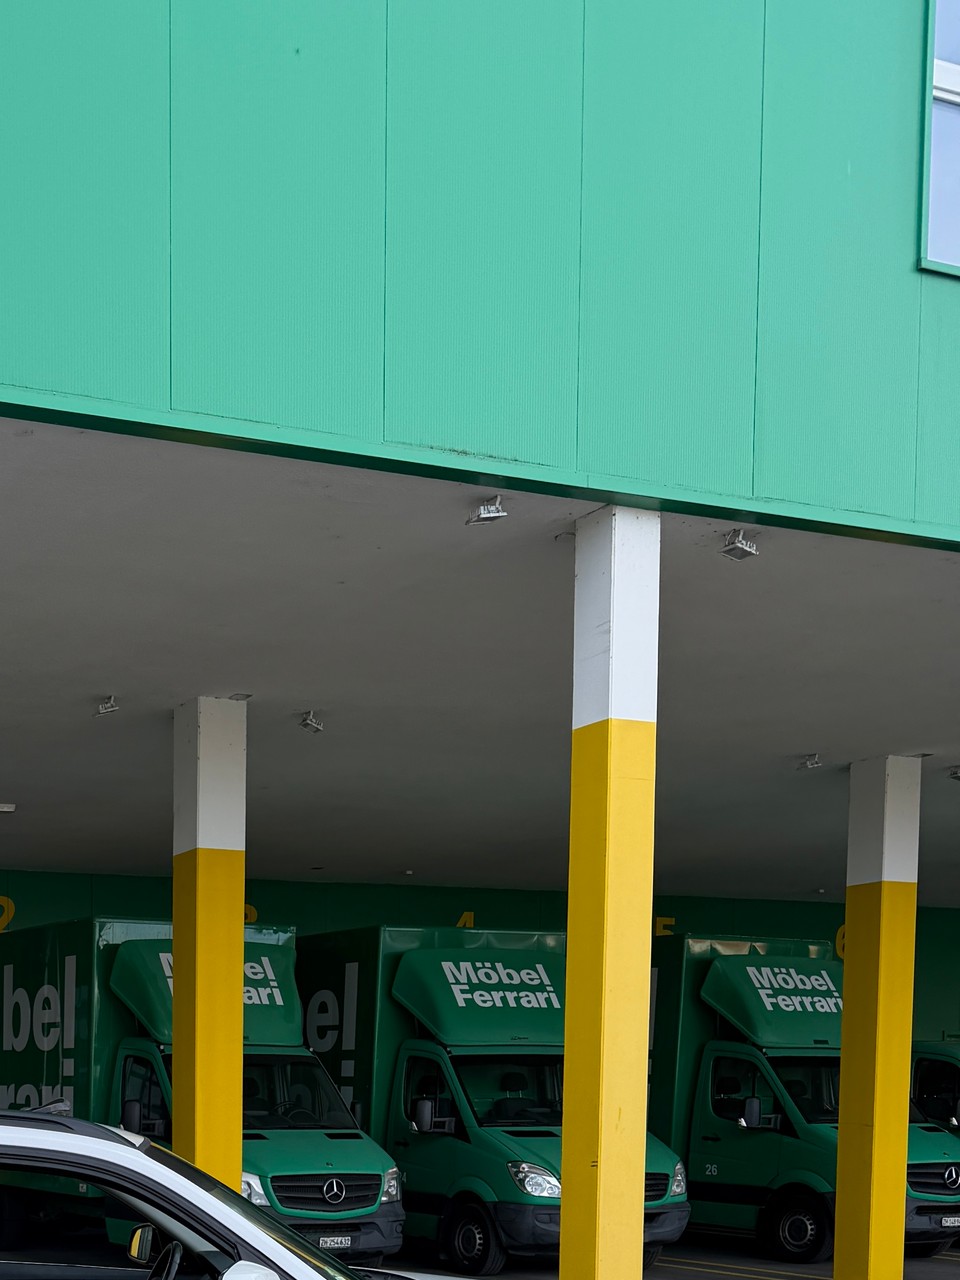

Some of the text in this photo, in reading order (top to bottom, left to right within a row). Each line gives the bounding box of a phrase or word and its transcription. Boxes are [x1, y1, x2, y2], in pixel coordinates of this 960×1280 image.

[441, 961, 552, 985] Möbel
[746, 966, 837, 991] Möbel
[450, 984, 562, 1009] Ferrari
[705, 1164, 718, 1176] 26
